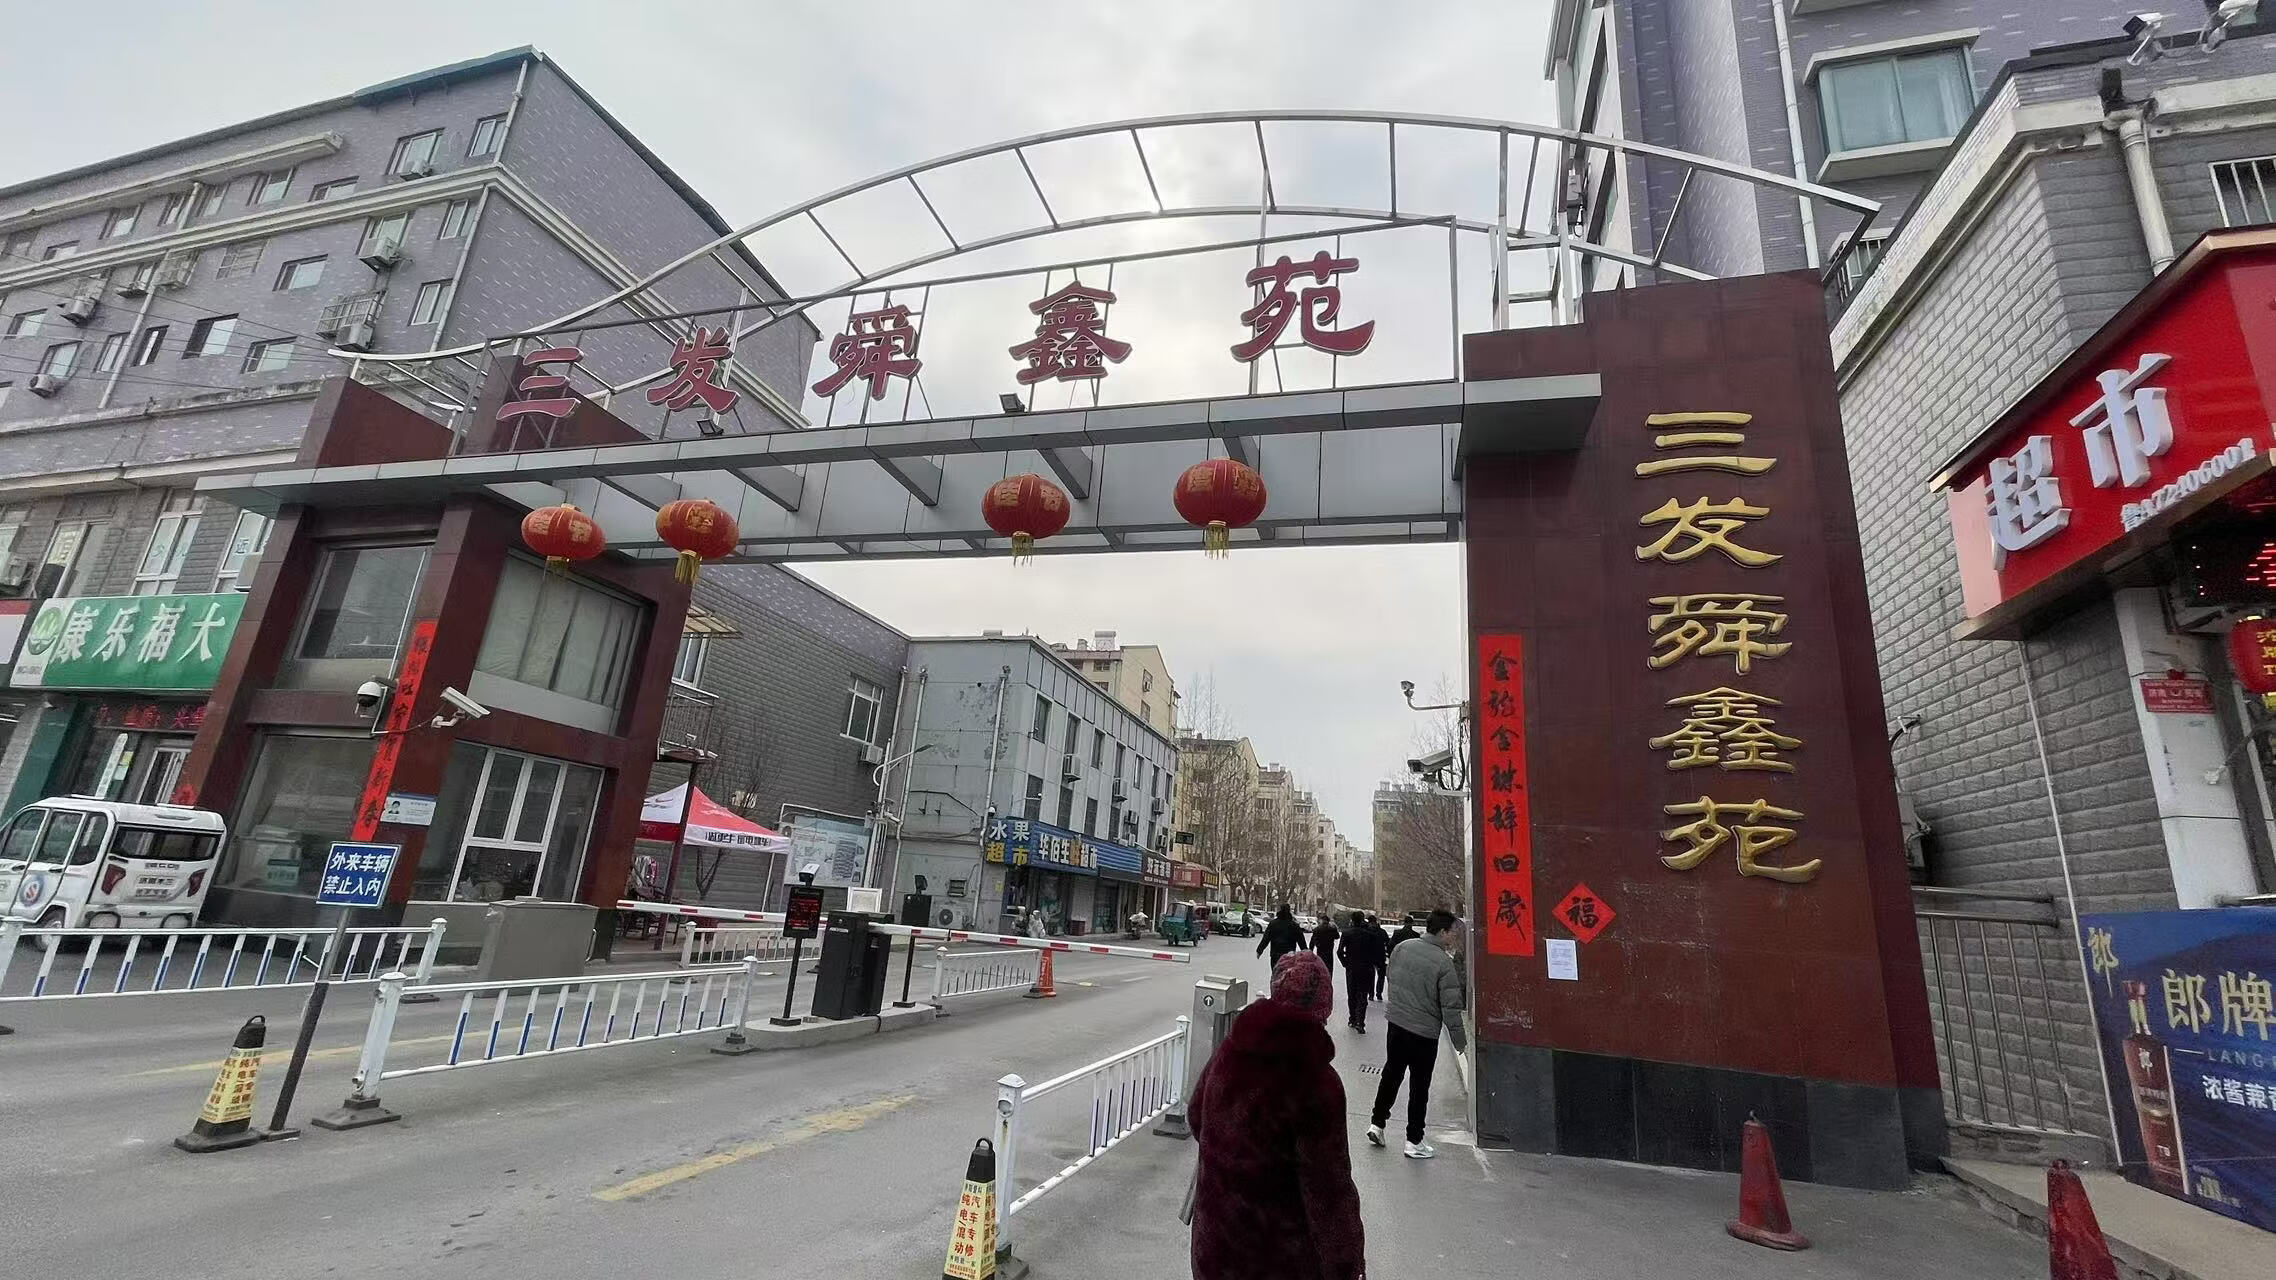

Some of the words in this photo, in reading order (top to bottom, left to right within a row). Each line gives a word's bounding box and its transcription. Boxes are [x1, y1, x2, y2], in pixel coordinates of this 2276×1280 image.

[496, 250, 1376, 422] 三发舜鑫苑
[1985, 353, 2172, 571] 超市
[1635, 411, 1822, 884] 三发舜鑫苑
[989, 820, 1030, 841] 水果
[329, 851, 392, 873] 外来车辆
[986, 841, 1029, 866] 超市
[323, 875, 381, 897] 禁止入内
[1566, 896, 1600, 929] 福
[2162, 968, 2276, 1041] 郎牌
